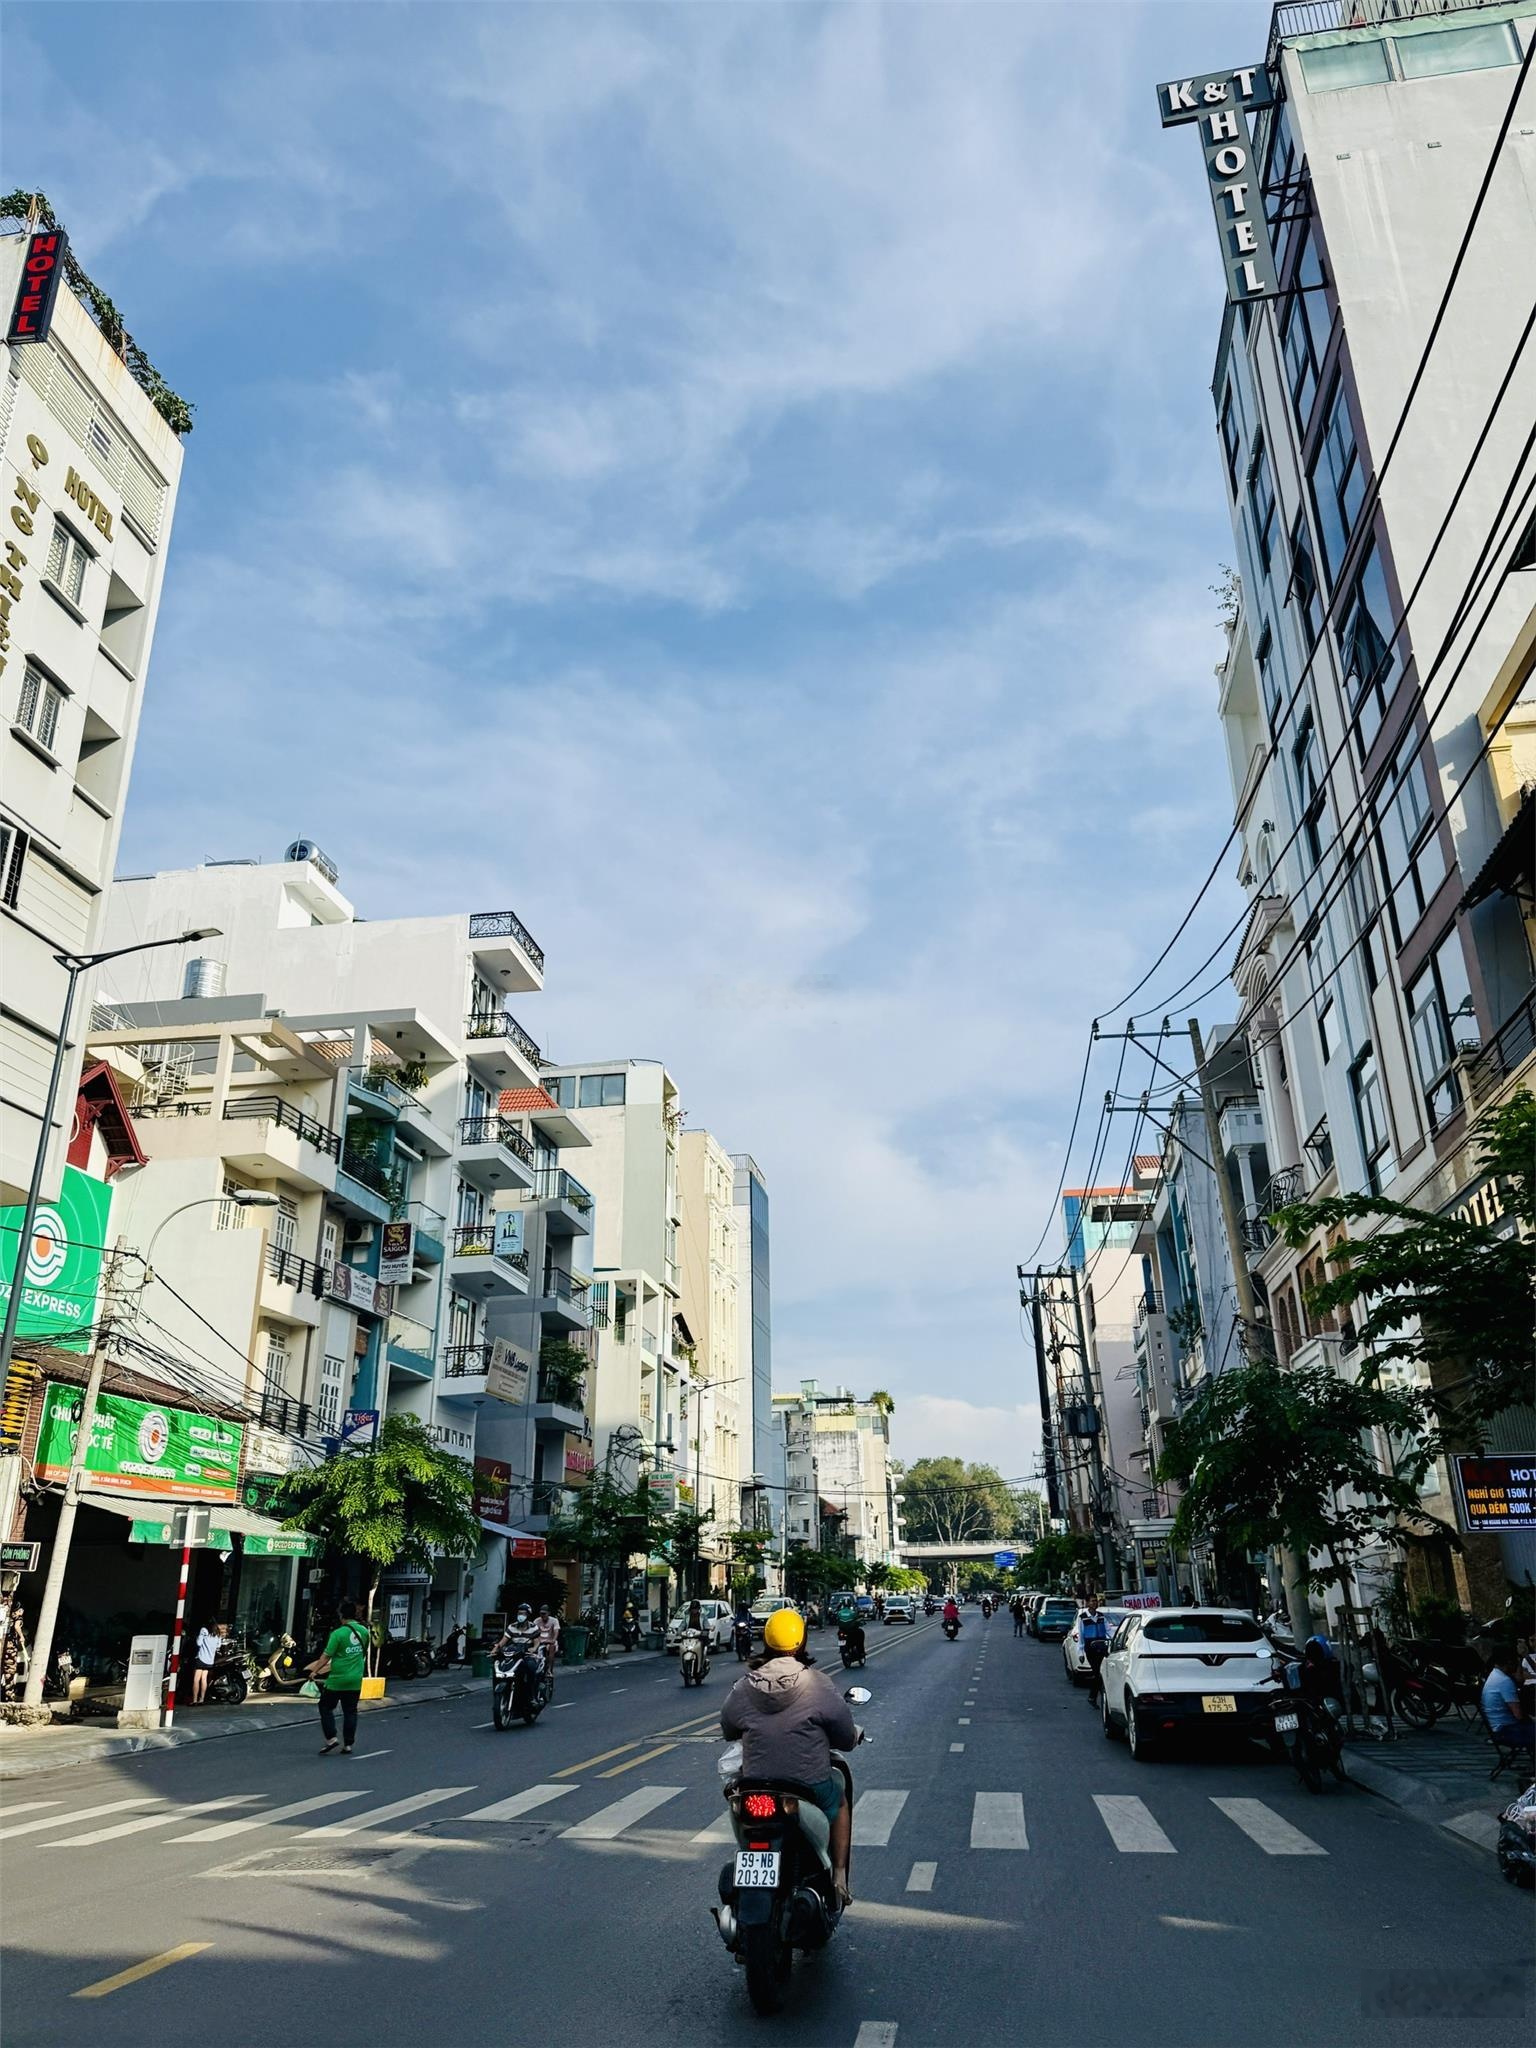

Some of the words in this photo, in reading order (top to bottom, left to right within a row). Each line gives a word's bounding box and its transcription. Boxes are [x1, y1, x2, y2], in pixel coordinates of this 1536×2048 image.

[1167, 68, 1256, 111] K&T
[1209, 109, 1265, 292] HOTEL
[16, 233, 58, 334] HOTEL
[64, 465, 114, 543] HOTEL
[24, 1287, 81, 1318] EXPRESS
[1506, 1487, 1528, 1499] 150K
[1509, 1502, 1532, 1514] 500K
[741, 1853, 774, 1868] 59-NB
[736, 1869, 776, 1886] 203.29
